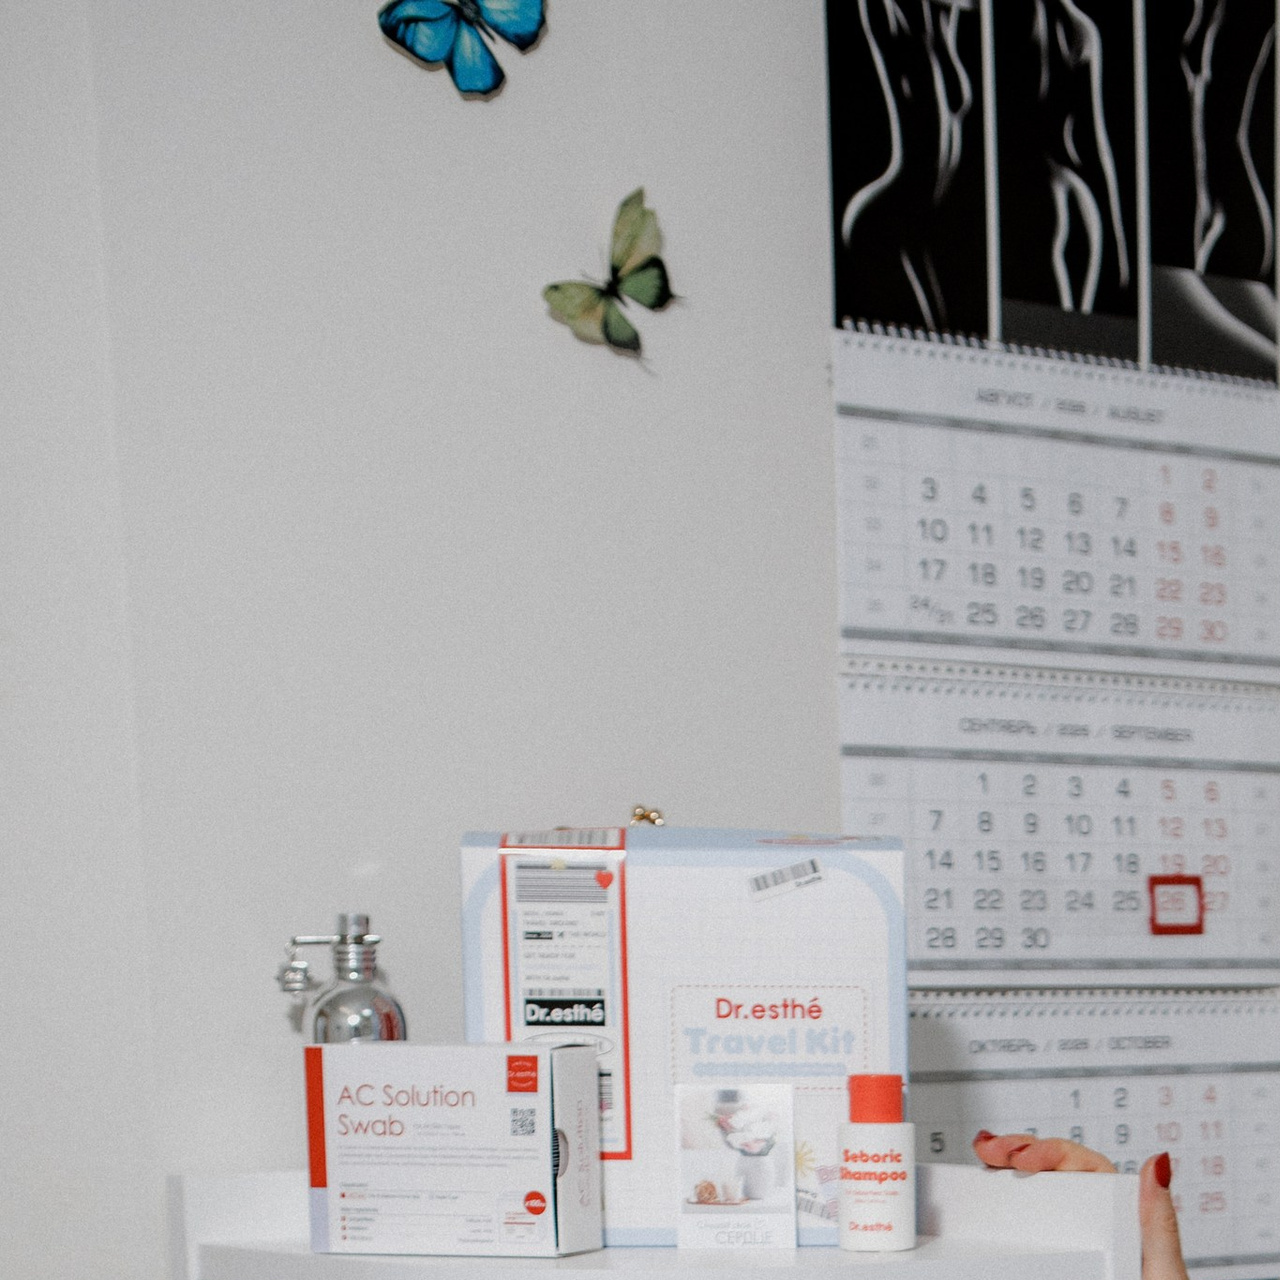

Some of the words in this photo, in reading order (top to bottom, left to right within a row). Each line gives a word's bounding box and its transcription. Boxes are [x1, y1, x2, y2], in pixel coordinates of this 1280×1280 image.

[1203, 468, 1217, 493] 2
[922, 477, 937, 501] 3
[971, 484, 987, 503] 4
[1021, 488, 1036, 511] 5
[1069, 493, 1083, 515] 6
[1116, 498, 1128, 519] 7
[1205, 507, 1218, 529] 9
[917, 519, 947, 541] 10
[969, 523, 994, 545] 11
[1017, 527, 1045, 550] 12
[1064, 532, 1092, 555] 13
[1111, 536, 1137, 558] 14
[1156, 540, 1182, 564] 15
[1200, 545, 1226, 566] 16
[919, 559, 946, 581] 17
[969, 563, 997, 585] 18
[1017, 567, 1045, 589] 19
[1062, 571, 1093, 593] 20
[1109, 574, 1136, 596] 21
[1156, 579, 1183, 601] 22
[1200, 582, 1226, 604] 23
[967, 602, 997, 624] 25
[1016, 605, 1046, 629] 26
[1062, 609, 1092, 632] 27
[1110, 613, 1139, 635] 28
[1156, 617, 1183, 639] 29
[1200, 620, 1227, 641] 30
[978, 773, 988, 793] 1
[1023, 774, 1036, 795] 2
[1068, 777, 1082, 797] 3
[1117, 778, 1130, 798] 4
[1161, 780, 1174, 801] 5
[1205, 782, 1218, 802] 6
[930, 810, 943, 830] 7
[978, 812, 993, 833] 8
[1025, 814, 1038, 834] 9
[1065, 815, 1092, 835] 10
[1113, 816, 1137, 837] 11
[1159, 818, 1183, 838] 12
[1203, 820, 1227, 839] 13
[925, 850, 954, 871] 14
[975, 851, 1001, 872] 15
[1021, 852, 1046, 873] 16
[1066, 853, 1092, 873] 17
[1113, 855, 1139, 874] 18
[1203, 856, 1230, 875] 20
[925, 888, 953, 909] 21
[974, 889, 1002, 909] 22
[1020, 889, 1047, 909] 23
[1066, 890, 1094, 910] 24
[1113, 891, 1140, 912] 25
[1160, 891, 1186, 912] 26
[926, 928, 956, 948] 28
[975, 928, 1003, 948] 29
[1021, 928, 1049, 948] 30
[525, 1003, 604, 1023] Dr.esthé
[715, 998, 823, 1020] Dr.esthé
[683, 1027, 797, 1054] Travel
[805, 1026, 855, 1054] Kit
[338, 1084, 374, 1106] AC
[382, 1084, 476, 1107] Solution
[1071, 1088, 1081, 1108] 1
[1114, 1087, 1128, 1108] 2
[1160, 1087, 1173, 1106] 3
[1203, 1084, 1217, 1103] 4
[338, 1114, 404, 1136] Swab
[930, 1132, 945, 1153] 5
[1115, 1123, 1129, 1144] 9
[1156, 1121, 1183, 1142] 10
[1200, 1120, 1223, 1139] 11
[843, 1149, 902, 1163] Seboric
[1200, 1193, 1226, 1213] 25
